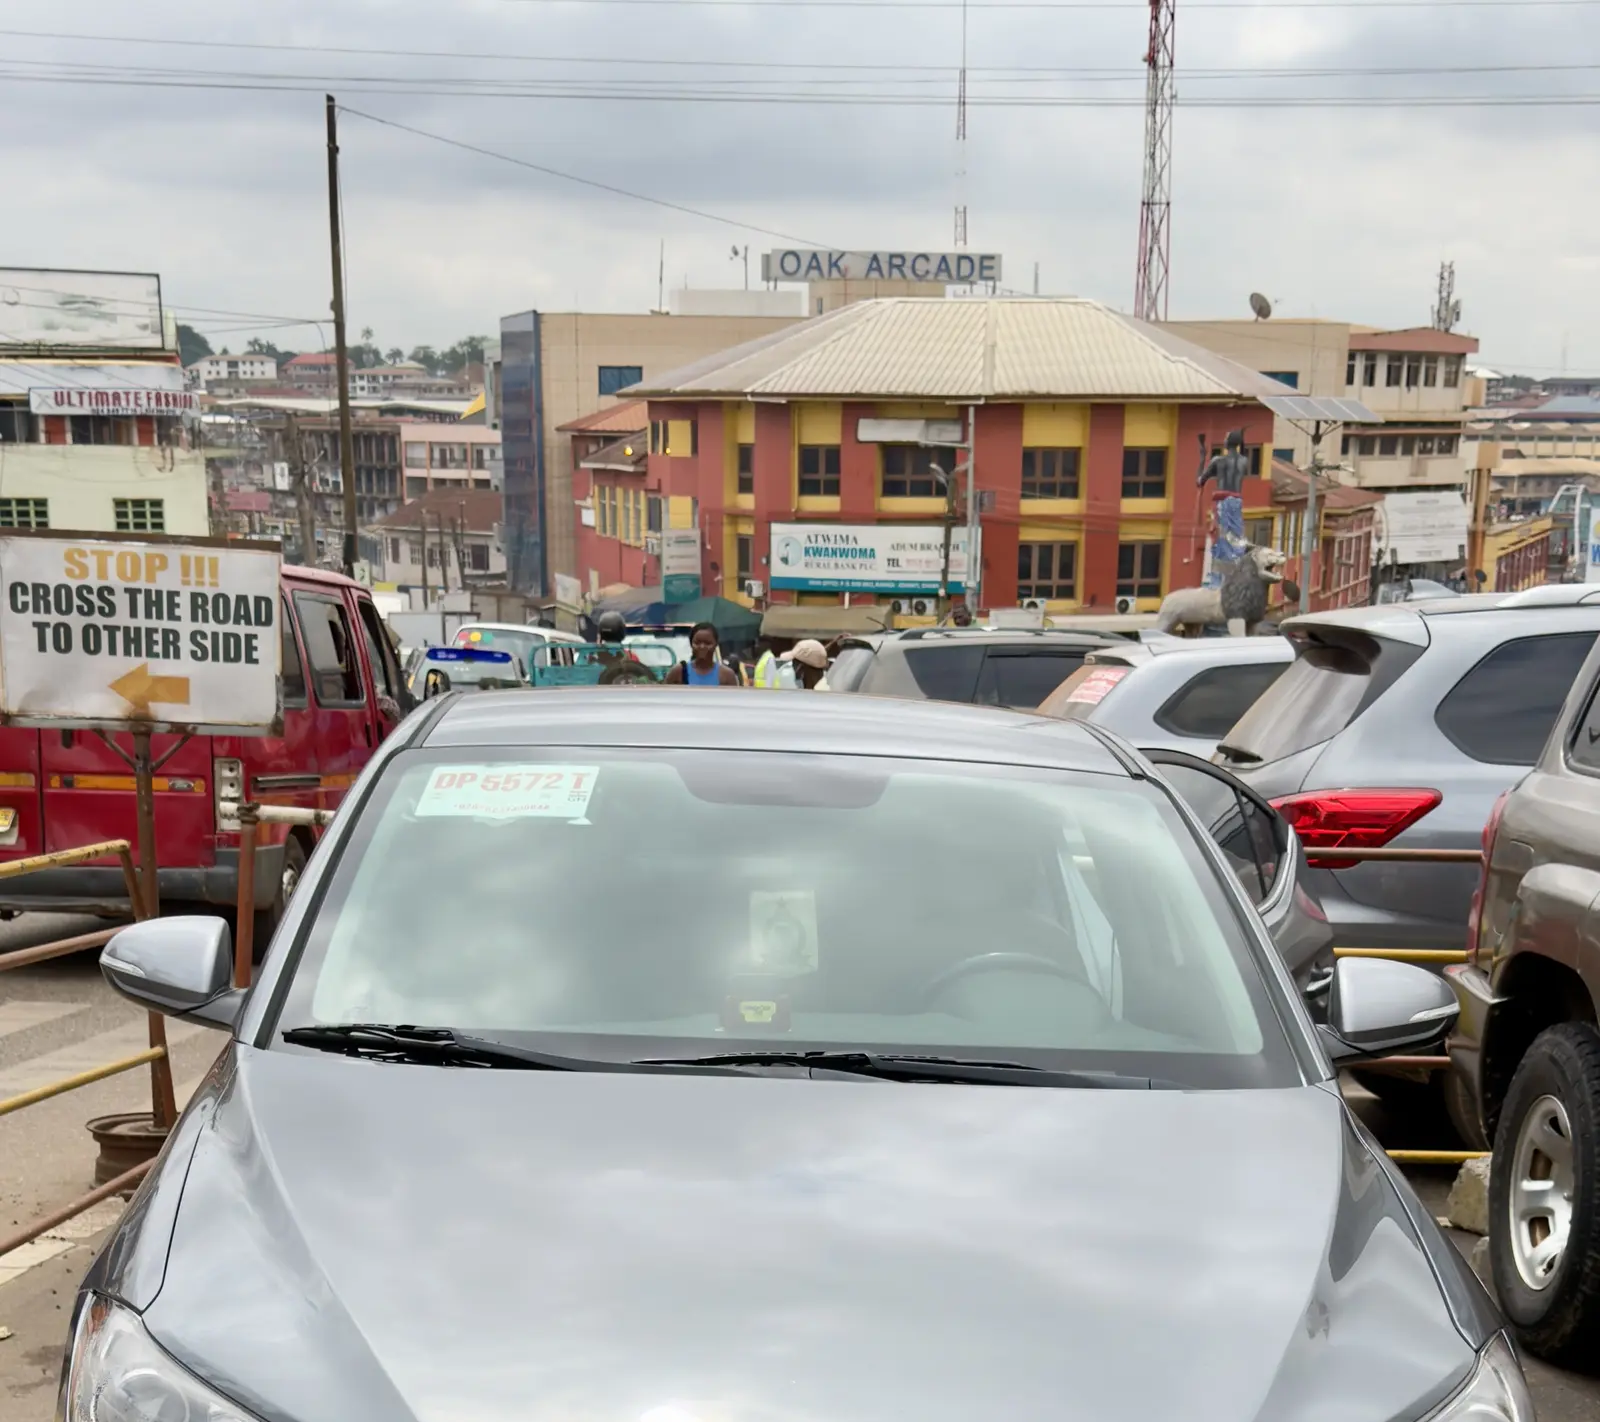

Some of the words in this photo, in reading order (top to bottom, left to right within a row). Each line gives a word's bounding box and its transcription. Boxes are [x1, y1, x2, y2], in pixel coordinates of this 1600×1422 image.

[780, 250, 846, 278] OAK
[865, 253, 996, 281] ARCADE
[54, 391, 141, 407] ULTIMATE
[804, 534, 858, 545] ATWIMA
[804, 546, 876, 559] KWANWOMA
[64, 548, 168, 583] STOP
[180, 554, 220, 587] !!!
[833, 562, 857, 570] BANK
[9, 581, 117, 618] CROSS
[124, 587, 182, 622] THE
[190, 591, 273, 627] ROAD
[32, 621, 73, 654] TO
[82, 623, 181, 660] OTHER
[189, 630, 259, 665] SIDE
[434, 772, 478, 790] DP
[480, 772, 564, 792] 5572
[571, 772, 591, 790] T
